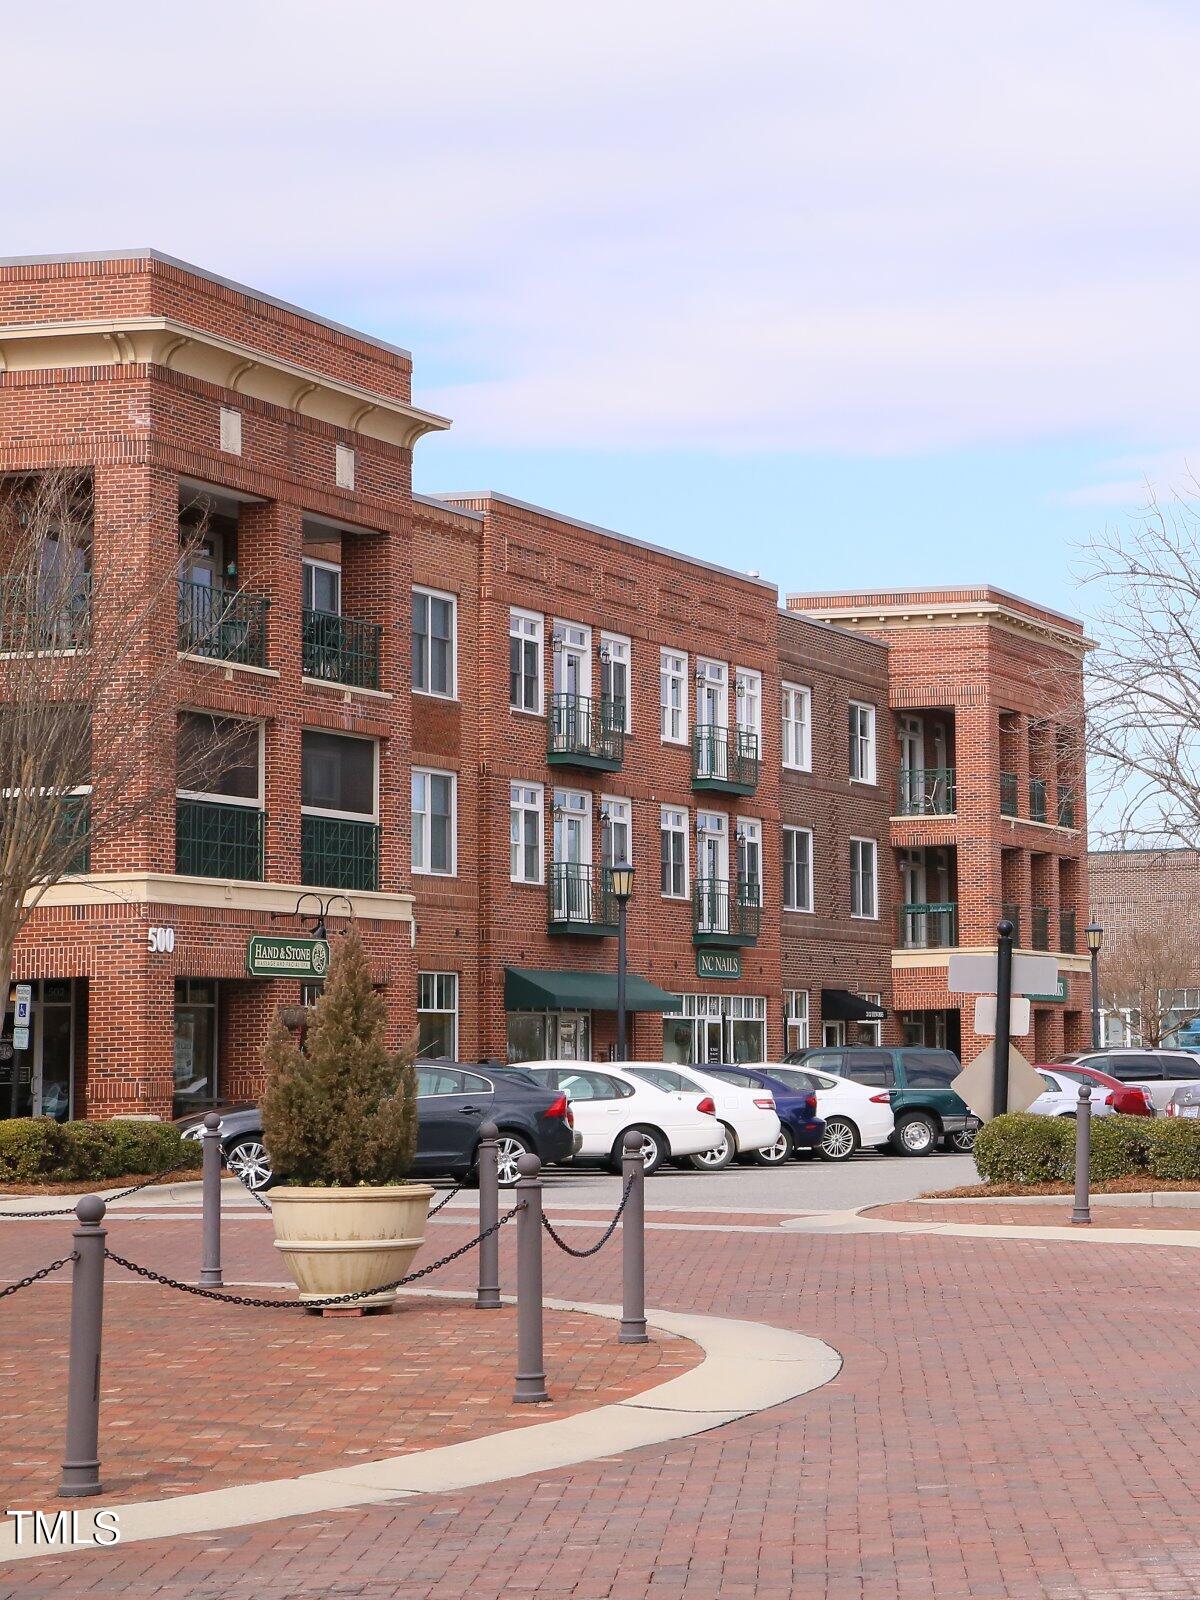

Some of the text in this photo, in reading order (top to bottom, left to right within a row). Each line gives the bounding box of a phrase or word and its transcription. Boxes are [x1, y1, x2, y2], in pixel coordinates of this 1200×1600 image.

[147, 927, 175, 953] 500
[255, 944, 311, 960] HAND & STONE
[701, 955, 738, 973] NC NAILS
